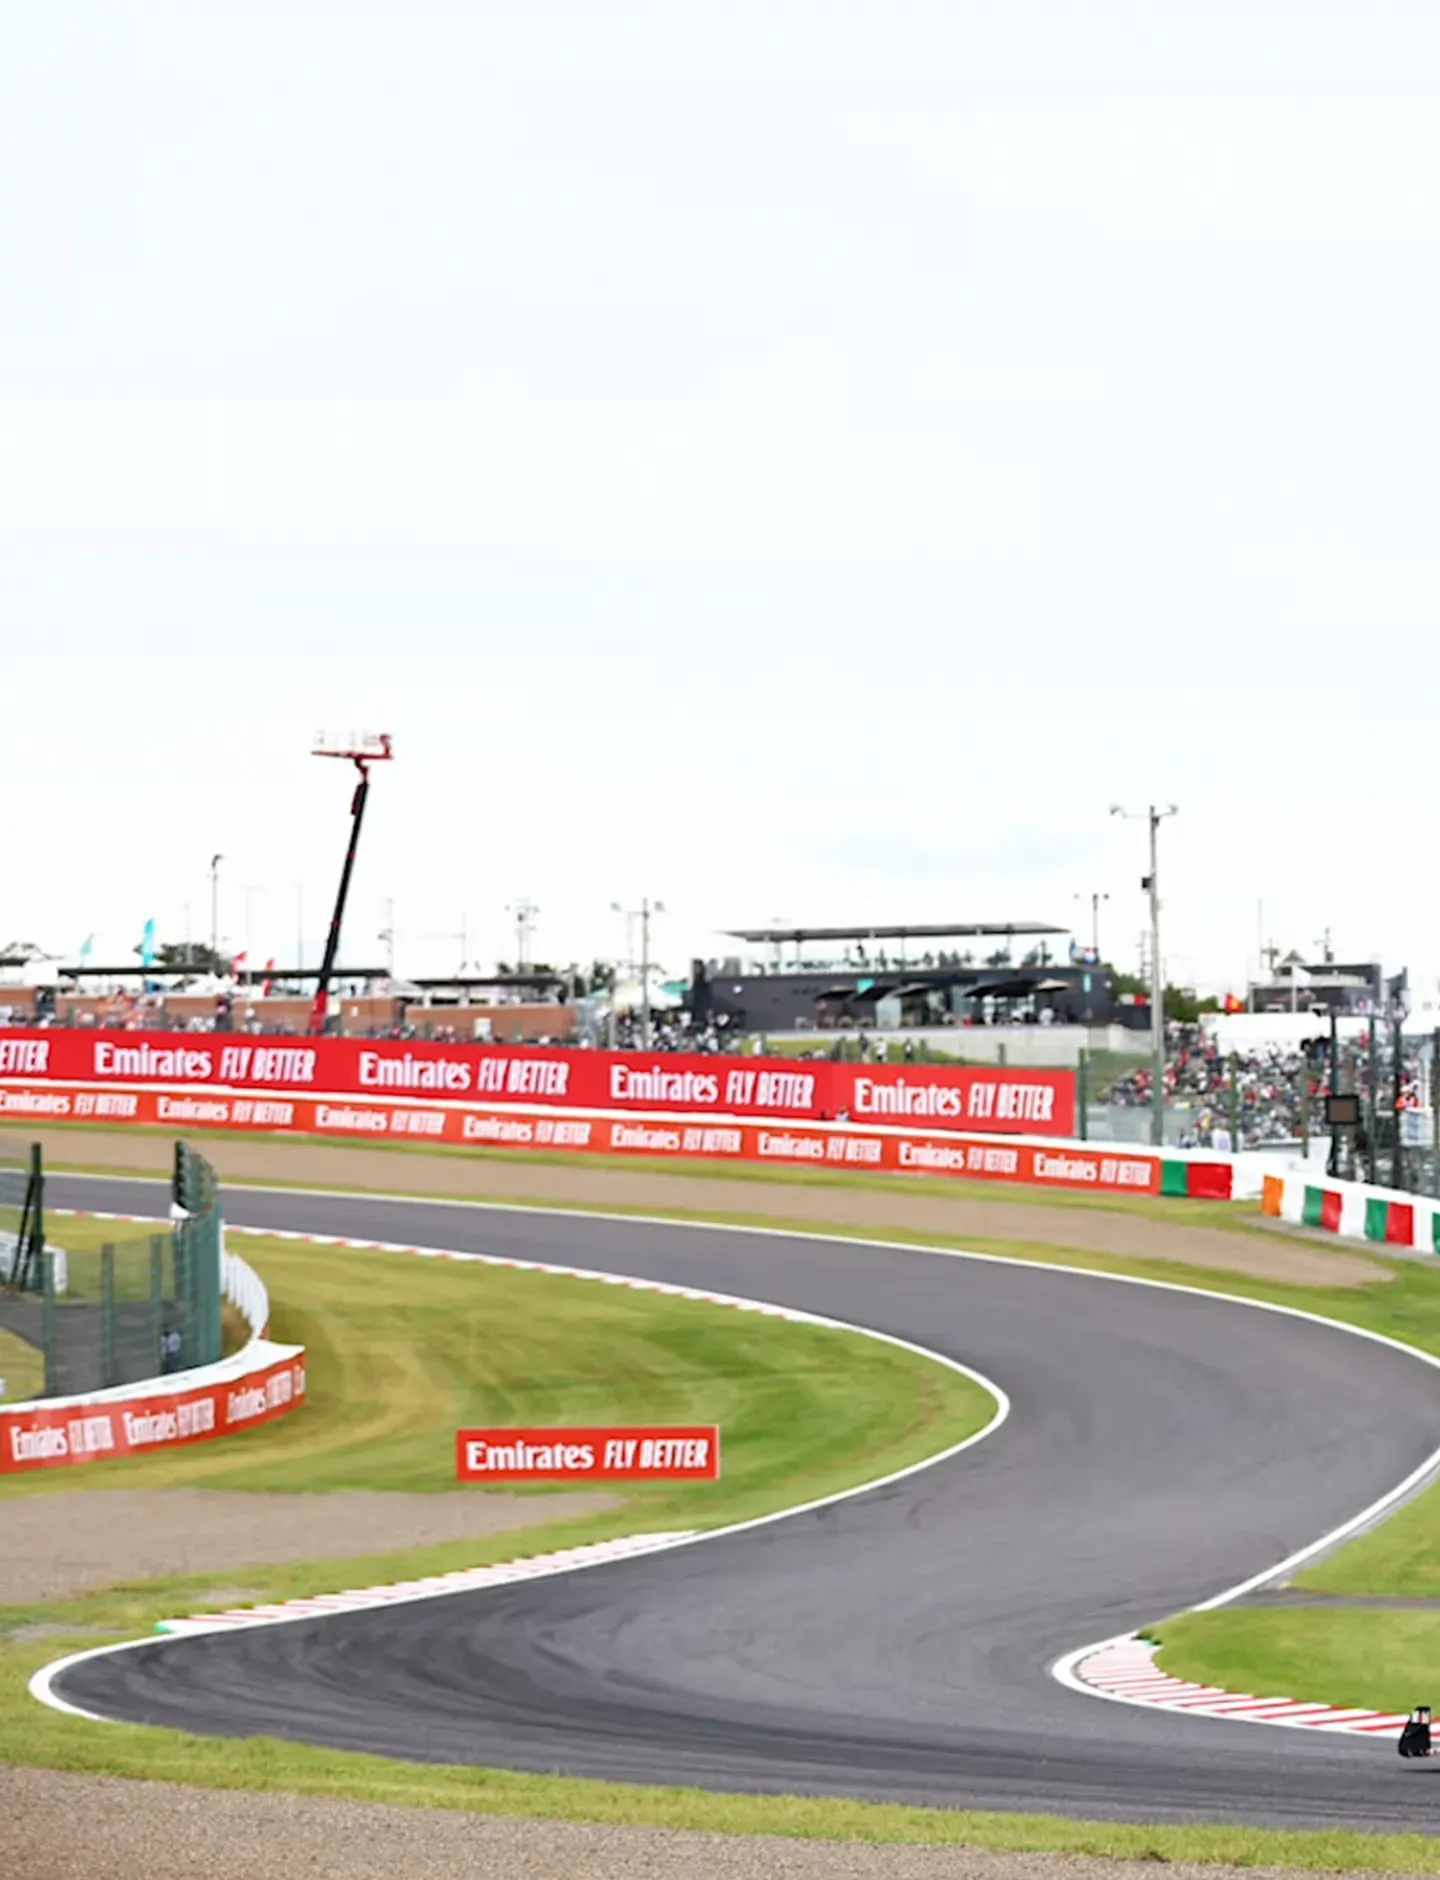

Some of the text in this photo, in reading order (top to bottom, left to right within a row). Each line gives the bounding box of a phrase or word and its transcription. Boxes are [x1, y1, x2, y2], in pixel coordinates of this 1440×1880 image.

[96, 1043, 315, 1081] Emirates FLY BETTER
[360, 1053, 568, 1094] Emirates FLY BETTER
[612, 1066, 814, 1107] Emirates FLY BETTER
[855, 1079, 1053, 1120] Emirates FLY BETTER
[467, 1440, 707, 1469] Emirates FLY BETTER
